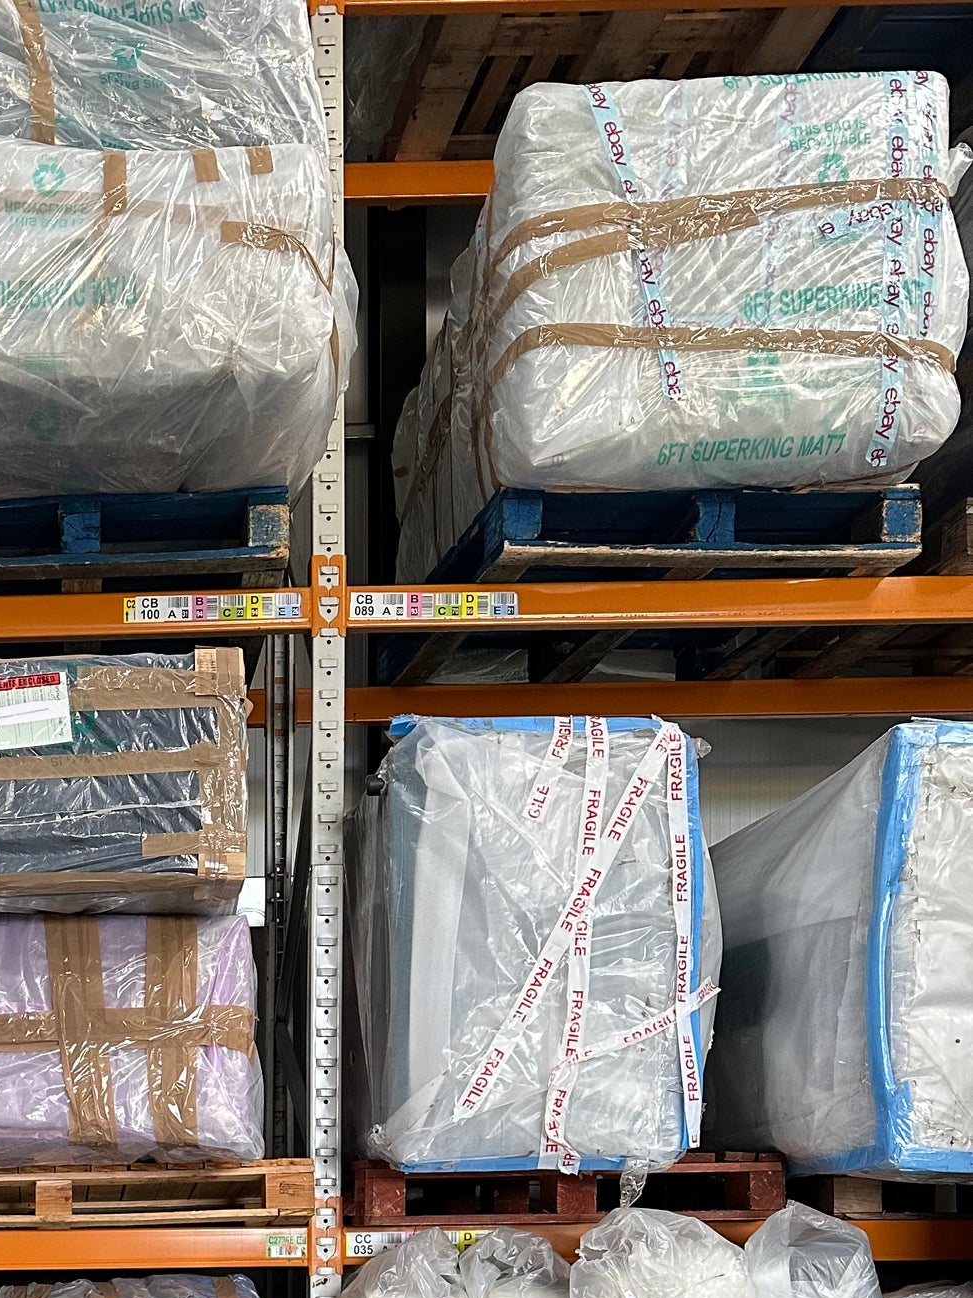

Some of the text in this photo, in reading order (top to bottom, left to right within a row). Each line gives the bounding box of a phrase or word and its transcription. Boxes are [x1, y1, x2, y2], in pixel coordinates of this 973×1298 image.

[791, 118, 867, 138] THIS BAG IS
[604, 121, 628, 166] ebay
[919, 228, 938, 278] ebay
[743, 290, 775, 321] 6FT
[875, 387, 902, 441] ebay
[656, 432, 847, 467] 6FT SUPERKING MATT
[141, 598, 159, 609] CB
[195, 597, 204, 606] B
[250, 595, 259, 604] D
[356, 594, 374, 605] CB
[411, 594, 419, 603] B
[466, 594, 475, 603] D
[140, 609, 160, 620] 100
[167, 610, 177, 619] A
[222, 607, 232, 617] C
[354, 606, 391, 616] 089 A
[438, 606, 446, 616] C
[493, 606, 501, 615] E
[18, 675, 56, 687] ENCLOSED
[670, 733, 684, 801] FRAGILE
[607, 776, 650, 841] FRAGILE
[582, 789, 601, 856] FRAGILE
[676, 834, 689, 902] FRAGILE
[560, 868, 602, 932] FRAGILE
[677, 935, 690, 1003] FRAGILE
[512, 958, 554, 1024] FRAGILE
[564, 990, 585, 1064] FRAGILE
[682, 1035, 700, 1102] FRAGILE
[461, 1048, 506, 1110] FRAGILE
[355, 1234, 372, 1244] CC
[463, 1232, 473, 1241] D
[353, 1245, 374, 1255] 035
